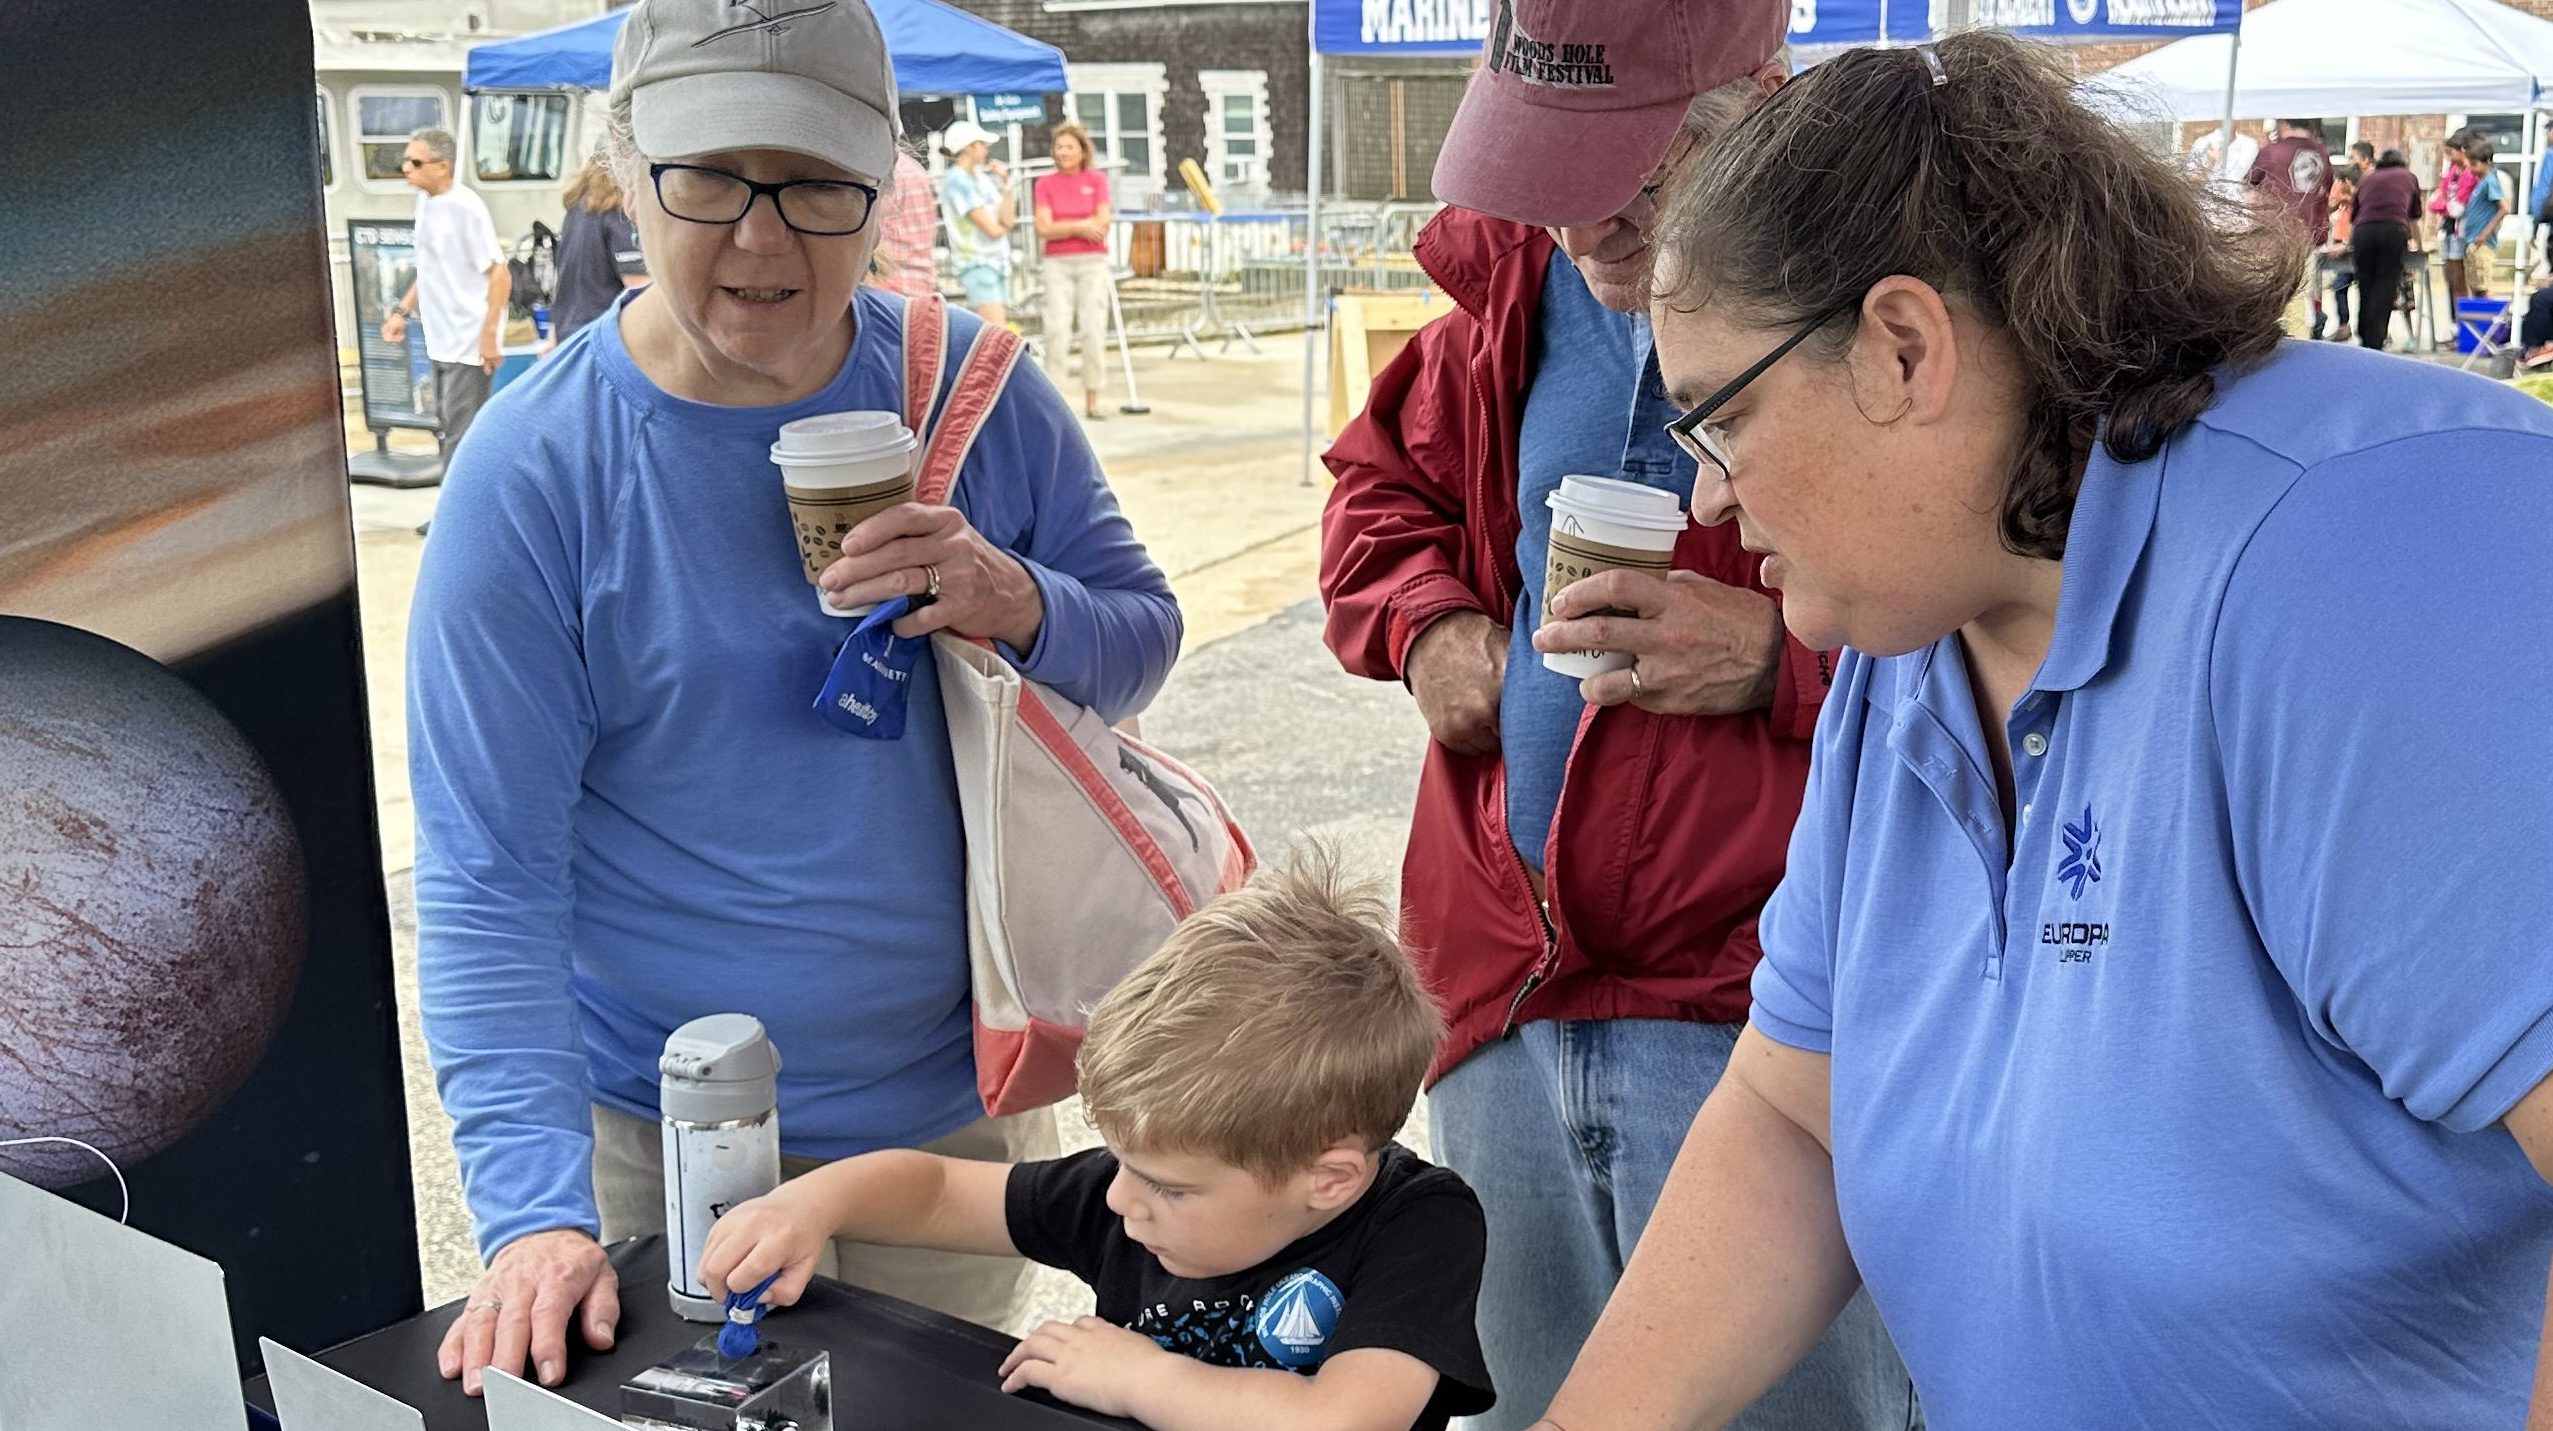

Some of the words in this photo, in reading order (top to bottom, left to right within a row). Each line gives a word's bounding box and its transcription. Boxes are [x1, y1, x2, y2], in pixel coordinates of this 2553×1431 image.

[1513, 33, 1555, 62] WOODS
[1562, 43, 1605, 64] HOLE
[1502, 51, 1533, 77] FILM
[1537, 61, 1615, 84] FESTIVAL
[2041, 922, 2109, 945] EUROPA
